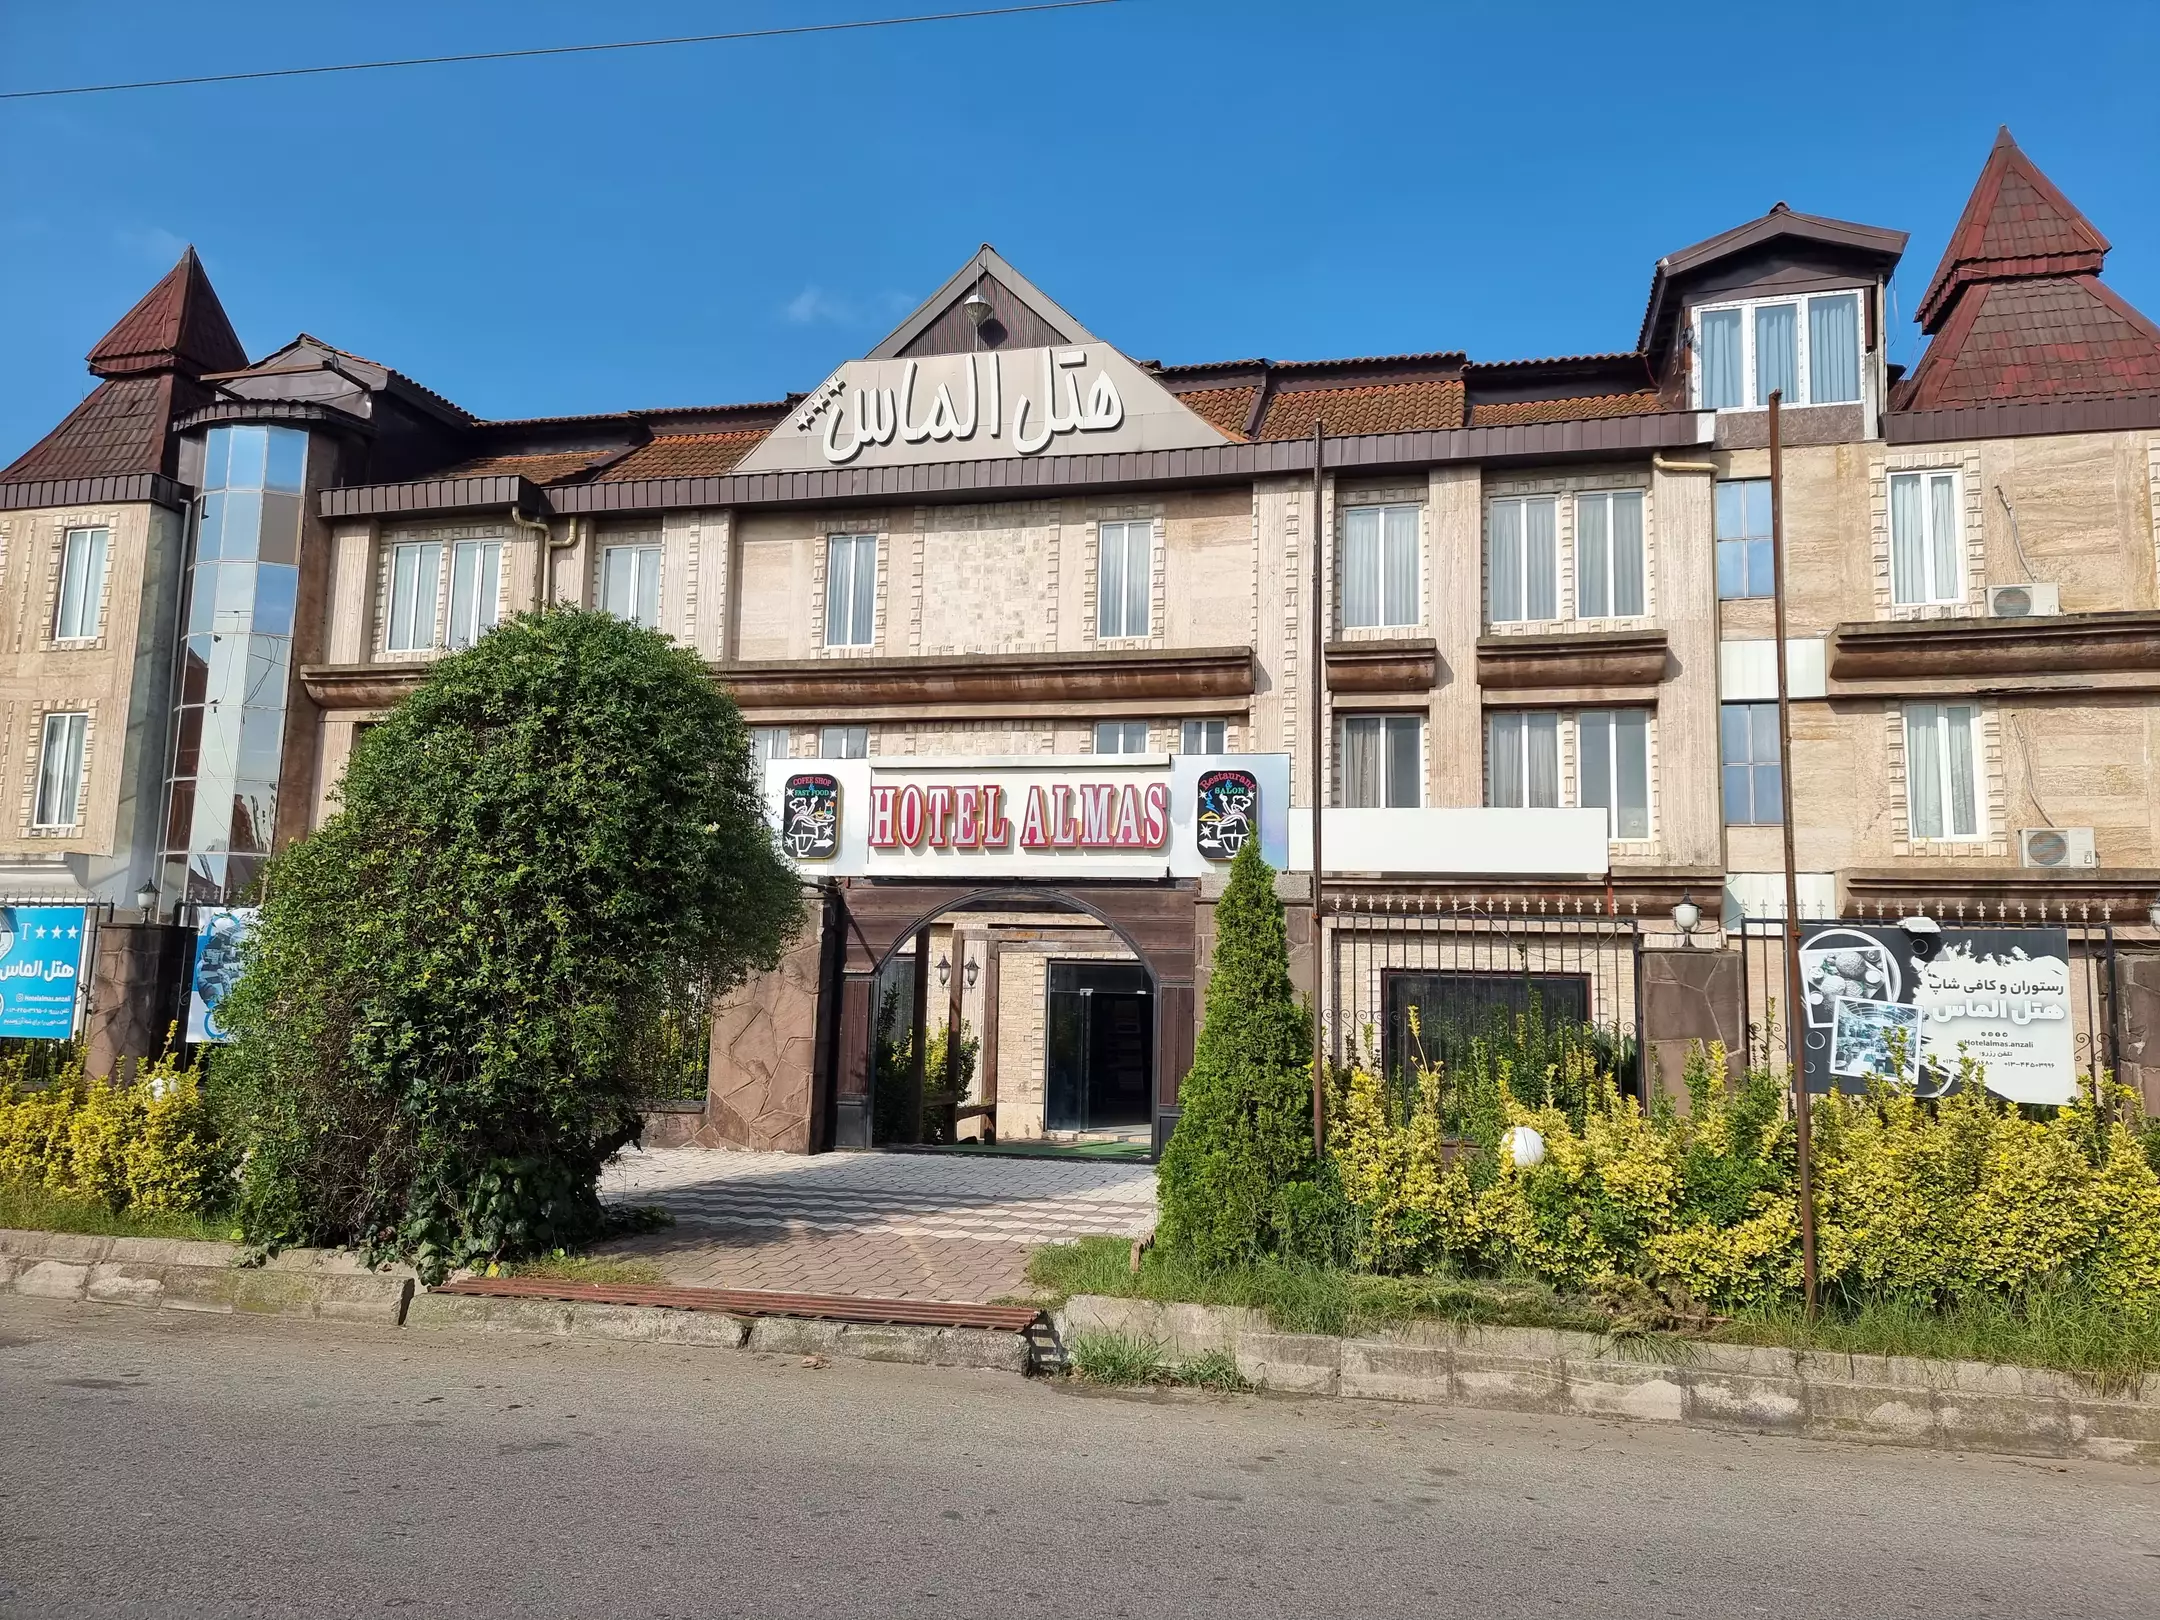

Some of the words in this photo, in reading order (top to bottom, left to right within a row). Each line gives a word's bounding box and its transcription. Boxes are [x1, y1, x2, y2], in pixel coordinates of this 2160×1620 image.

[822, 350, 1001, 463] الماس
[1012, 346, 1125, 455] هتل
[793, 776, 815, 786] COFEE
[815, 776, 832, 787] SHOP
[1199, 771, 1257, 791] Restaurant
[1214, 786, 1245, 795] SALON
[1225, 779, 1233, 788] &
[868, 784, 1008, 849] HOTEL
[1020, 782, 1169, 849] ALMAS
[0, 959, 43, 981] الماس
[44, 960, 75, 982] هتل
[1929, 978, 1960, 995] شاپ
[1964, 979, 1997, 993] کافی
[1999, 983, 2007, 994] و
[2010, 980, 2064, 995] رستوران
[1932, 998, 2008, 1023] الماس
[2011, 1000, 2065, 1025] هتل
